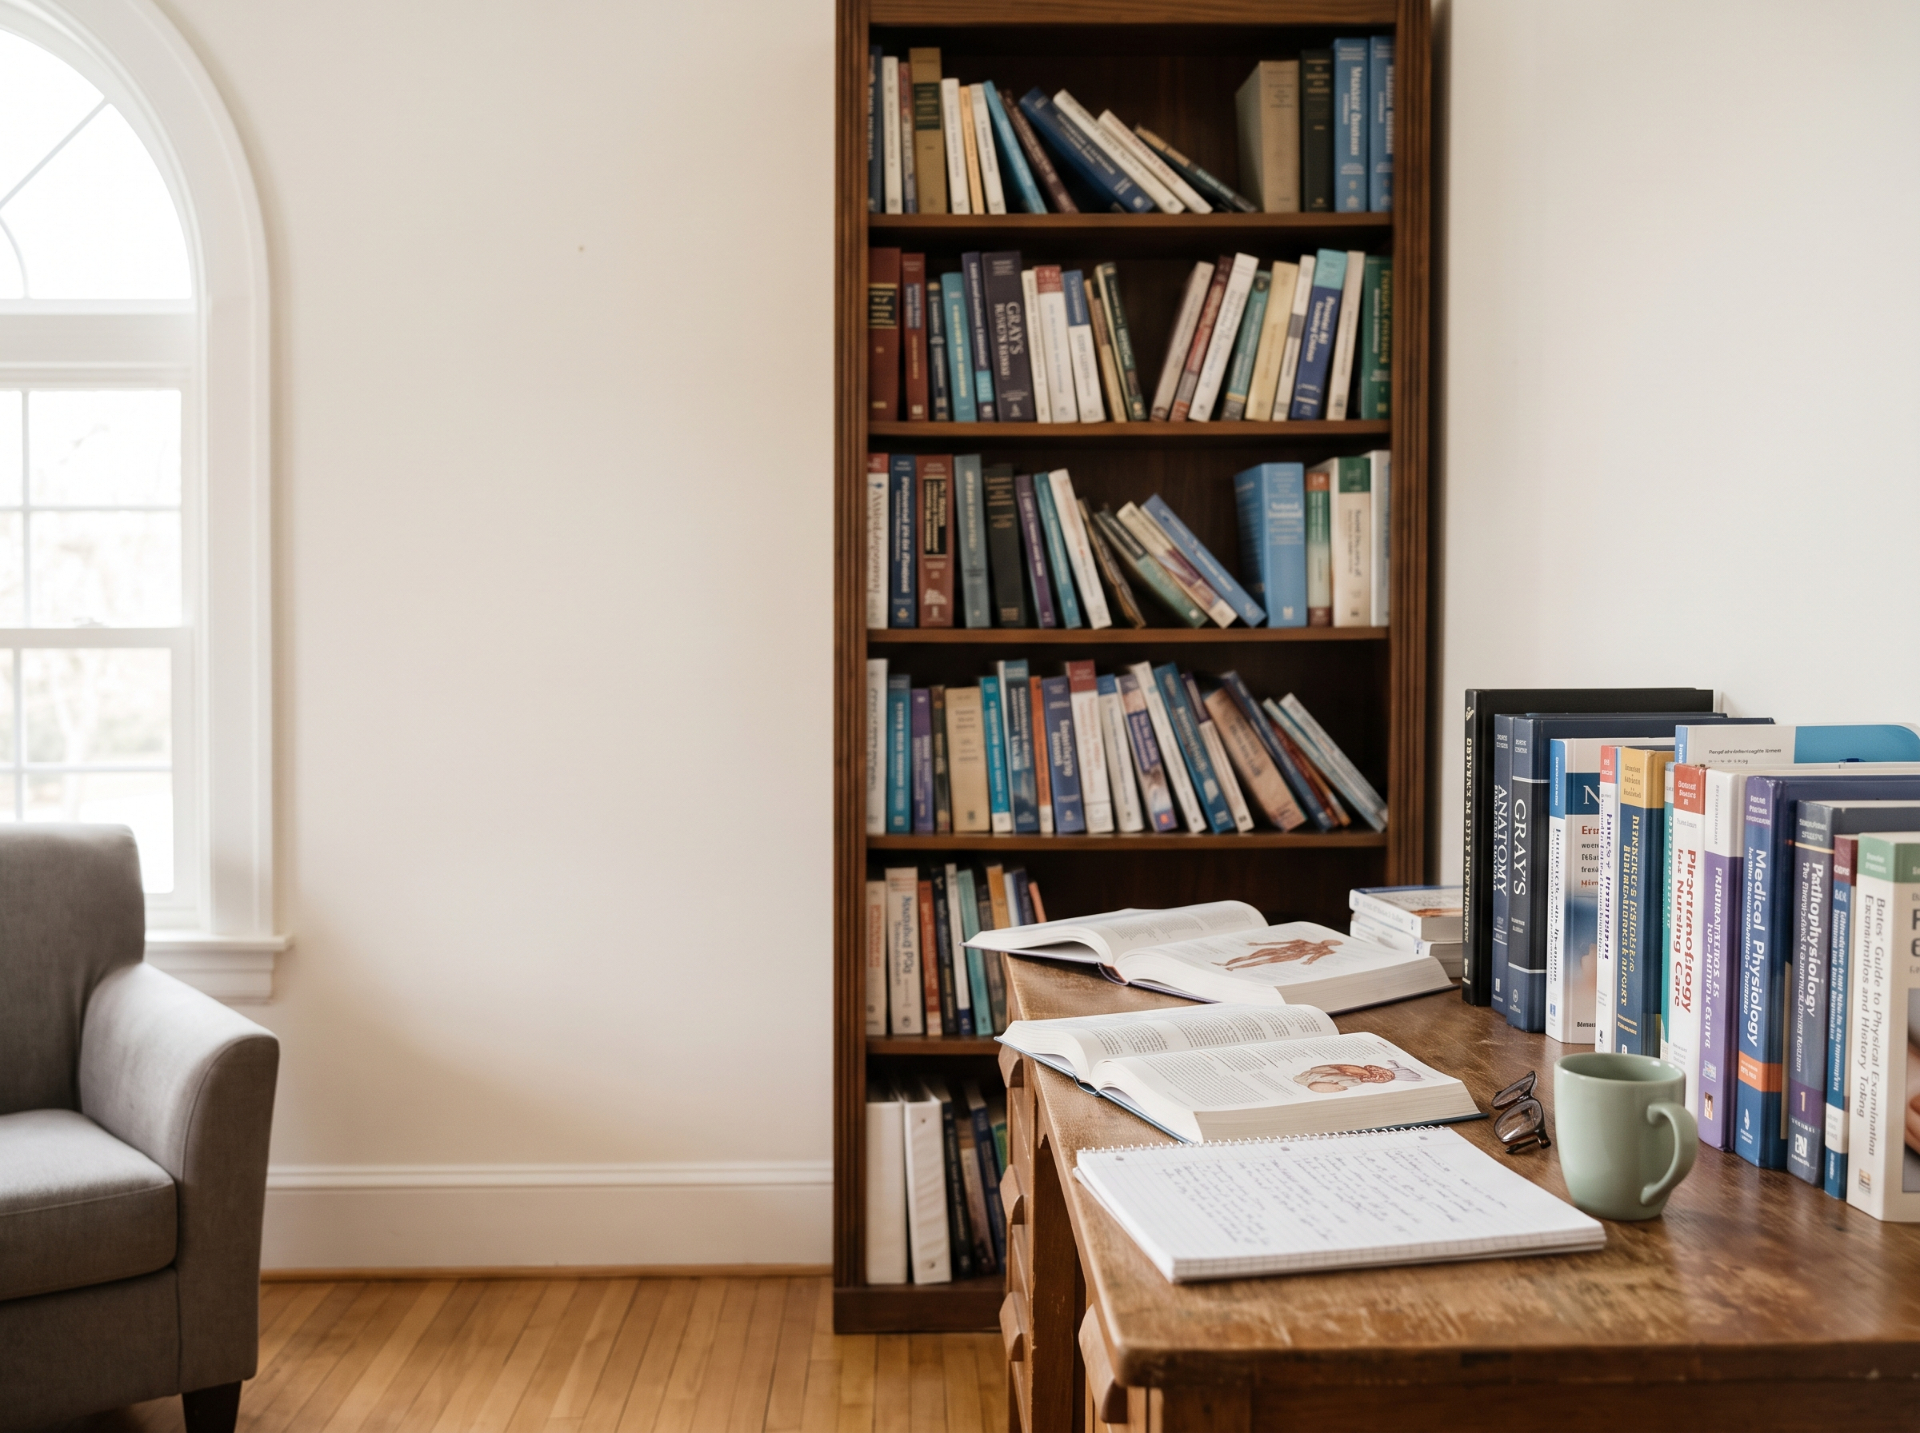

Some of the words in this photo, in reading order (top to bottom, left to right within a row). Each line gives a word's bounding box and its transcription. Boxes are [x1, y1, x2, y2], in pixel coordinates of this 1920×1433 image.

[1497, 784, 1508, 897] ANATOMY
[1513, 798, 1527, 896] GRAY'S
[1673, 880, 1685, 954] Nursing
[1805, 862, 1824, 1017] Pathophysiology
[1674, 961, 1683, 1007] Care
[1747, 939, 1765, 1047] Physiology
[1873, 946, 1885, 987] Guide
[1861, 987, 1871, 1013] and
[1873, 992, 1882, 1006] to
[1857, 1017, 1870, 1070] History
[1870, 1010, 1882, 1067] Physical
[1800, 1091, 1806, 1112] 1
[1868, 1071, 1880, 1157] Examination
